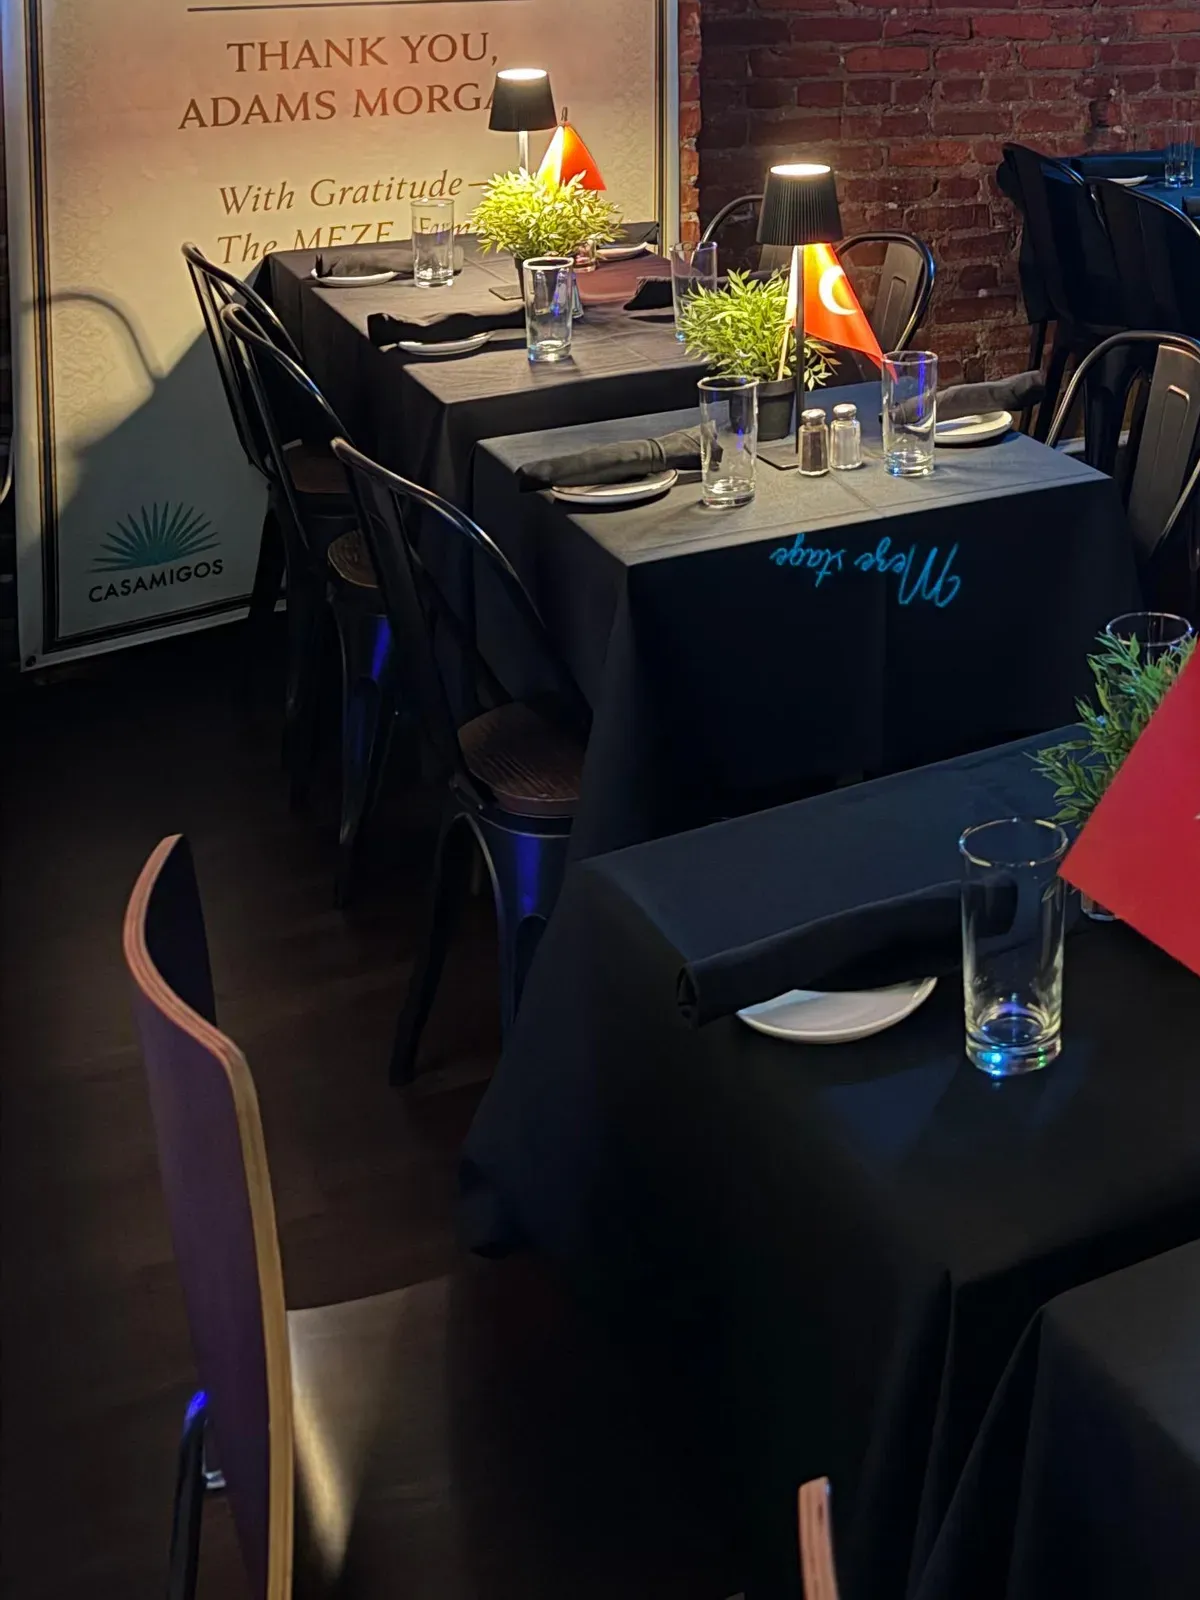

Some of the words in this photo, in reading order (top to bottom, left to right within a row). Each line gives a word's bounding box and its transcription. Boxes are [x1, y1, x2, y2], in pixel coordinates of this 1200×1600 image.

[226, 36, 388, 73] THANK
[400, 32, 498, 66] YOU,
[177, 90, 337, 130] ADAMS
[353, 82, 494, 118] MORG
[218, 181, 295, 216] With
[217, 233, 278, 265] The
[88, 558, 224, 603] CASAMIGOS
